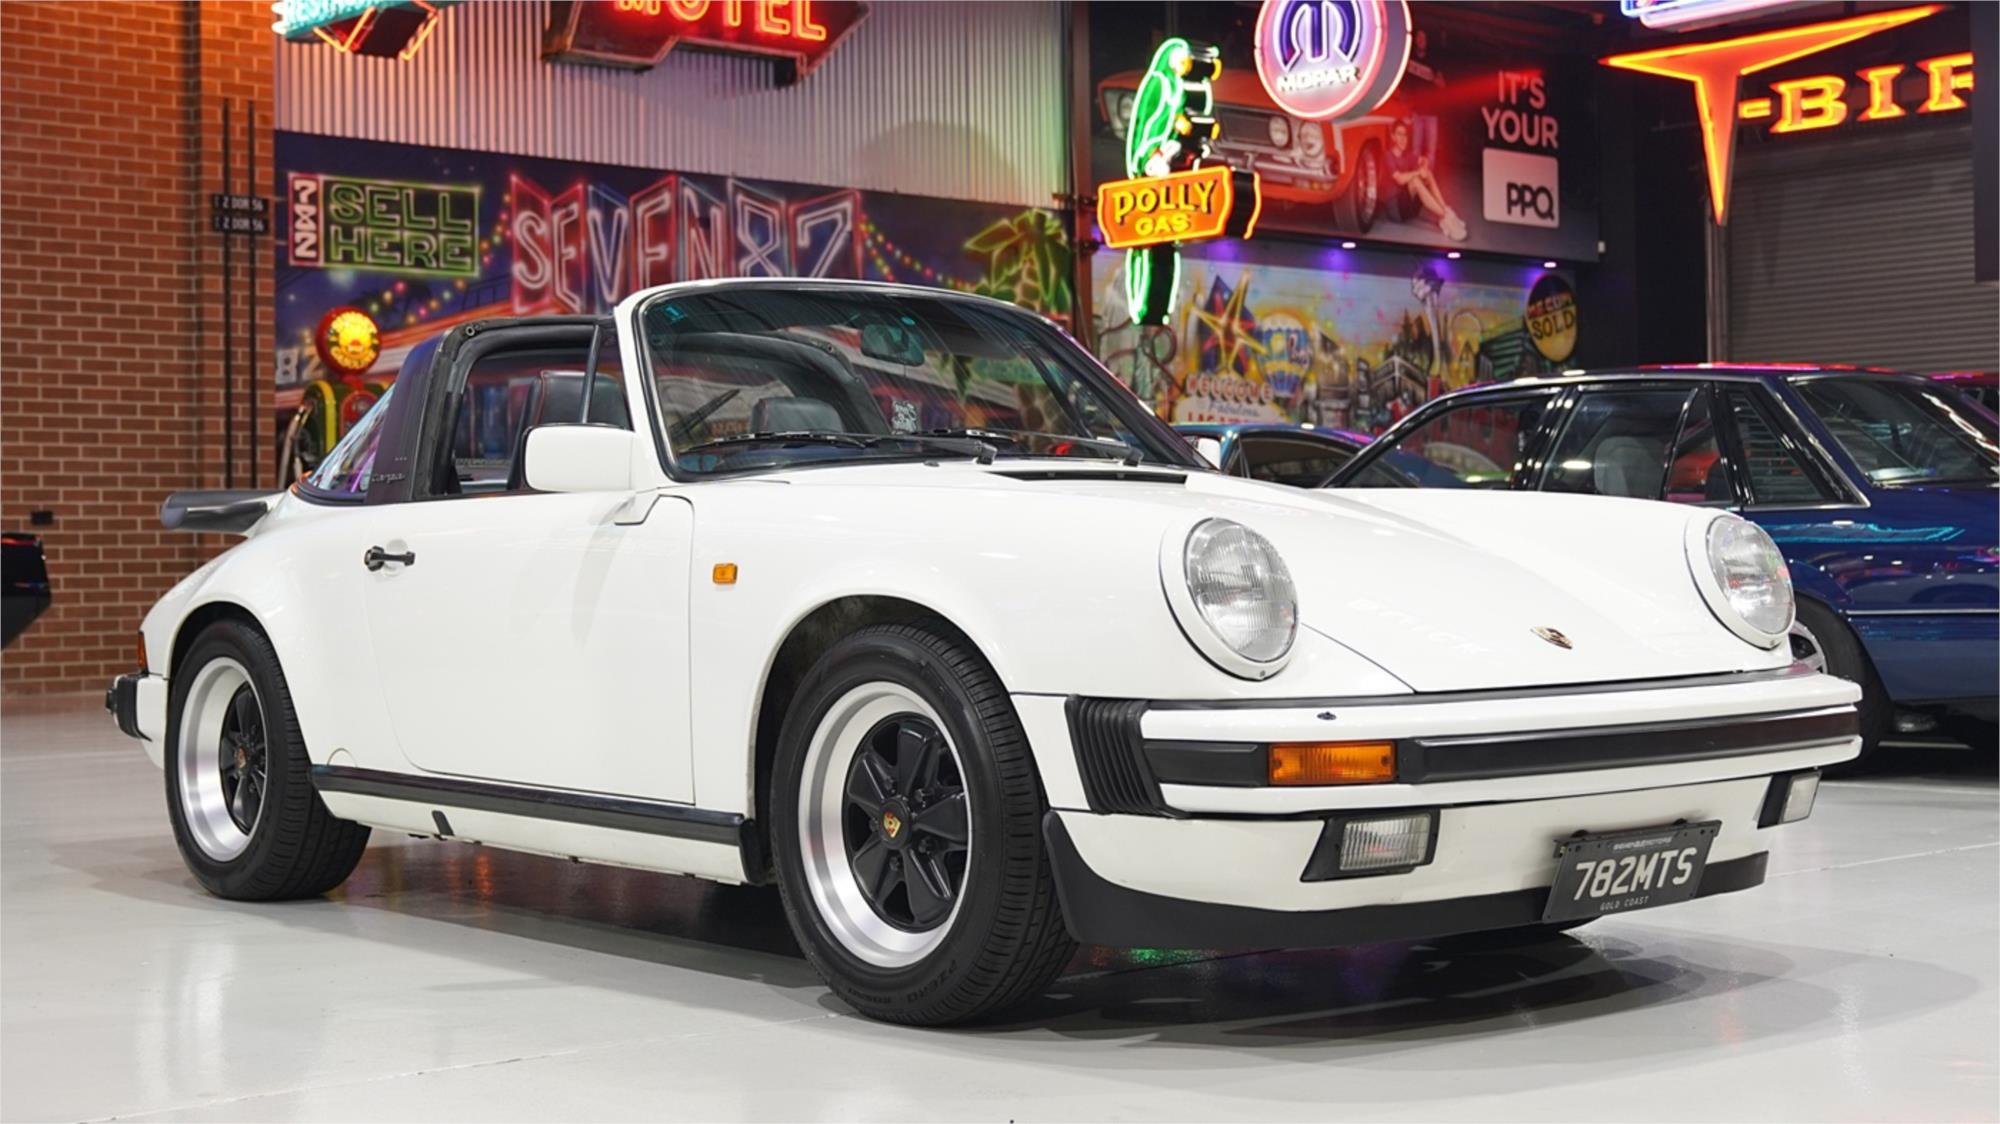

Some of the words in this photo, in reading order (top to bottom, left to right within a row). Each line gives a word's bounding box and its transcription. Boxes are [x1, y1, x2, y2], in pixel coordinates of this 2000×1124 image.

[1276, 63, 1359, 92] MOPAR
[1498, 70, 1546, 109] IT'S
[1481, 106, 1559, 149] YOUR
[329, 183, 472, 233] SELL
[1112, 179, 1216, 225] POLLY
[1506, 181, 1556, 221] PPQ
[1135, 212, 1189, 236] GAS
[329, 224, 472, 271] HERE
[1531, 310, 1574, 340] SOLD
[1186, 374, 1274, 404] WELCOME
[1573, 847, 1697, 901] 782MTS
[1599, 900, 1621, 911] GOLD
[1624, 896, 1650, 908] COAST
